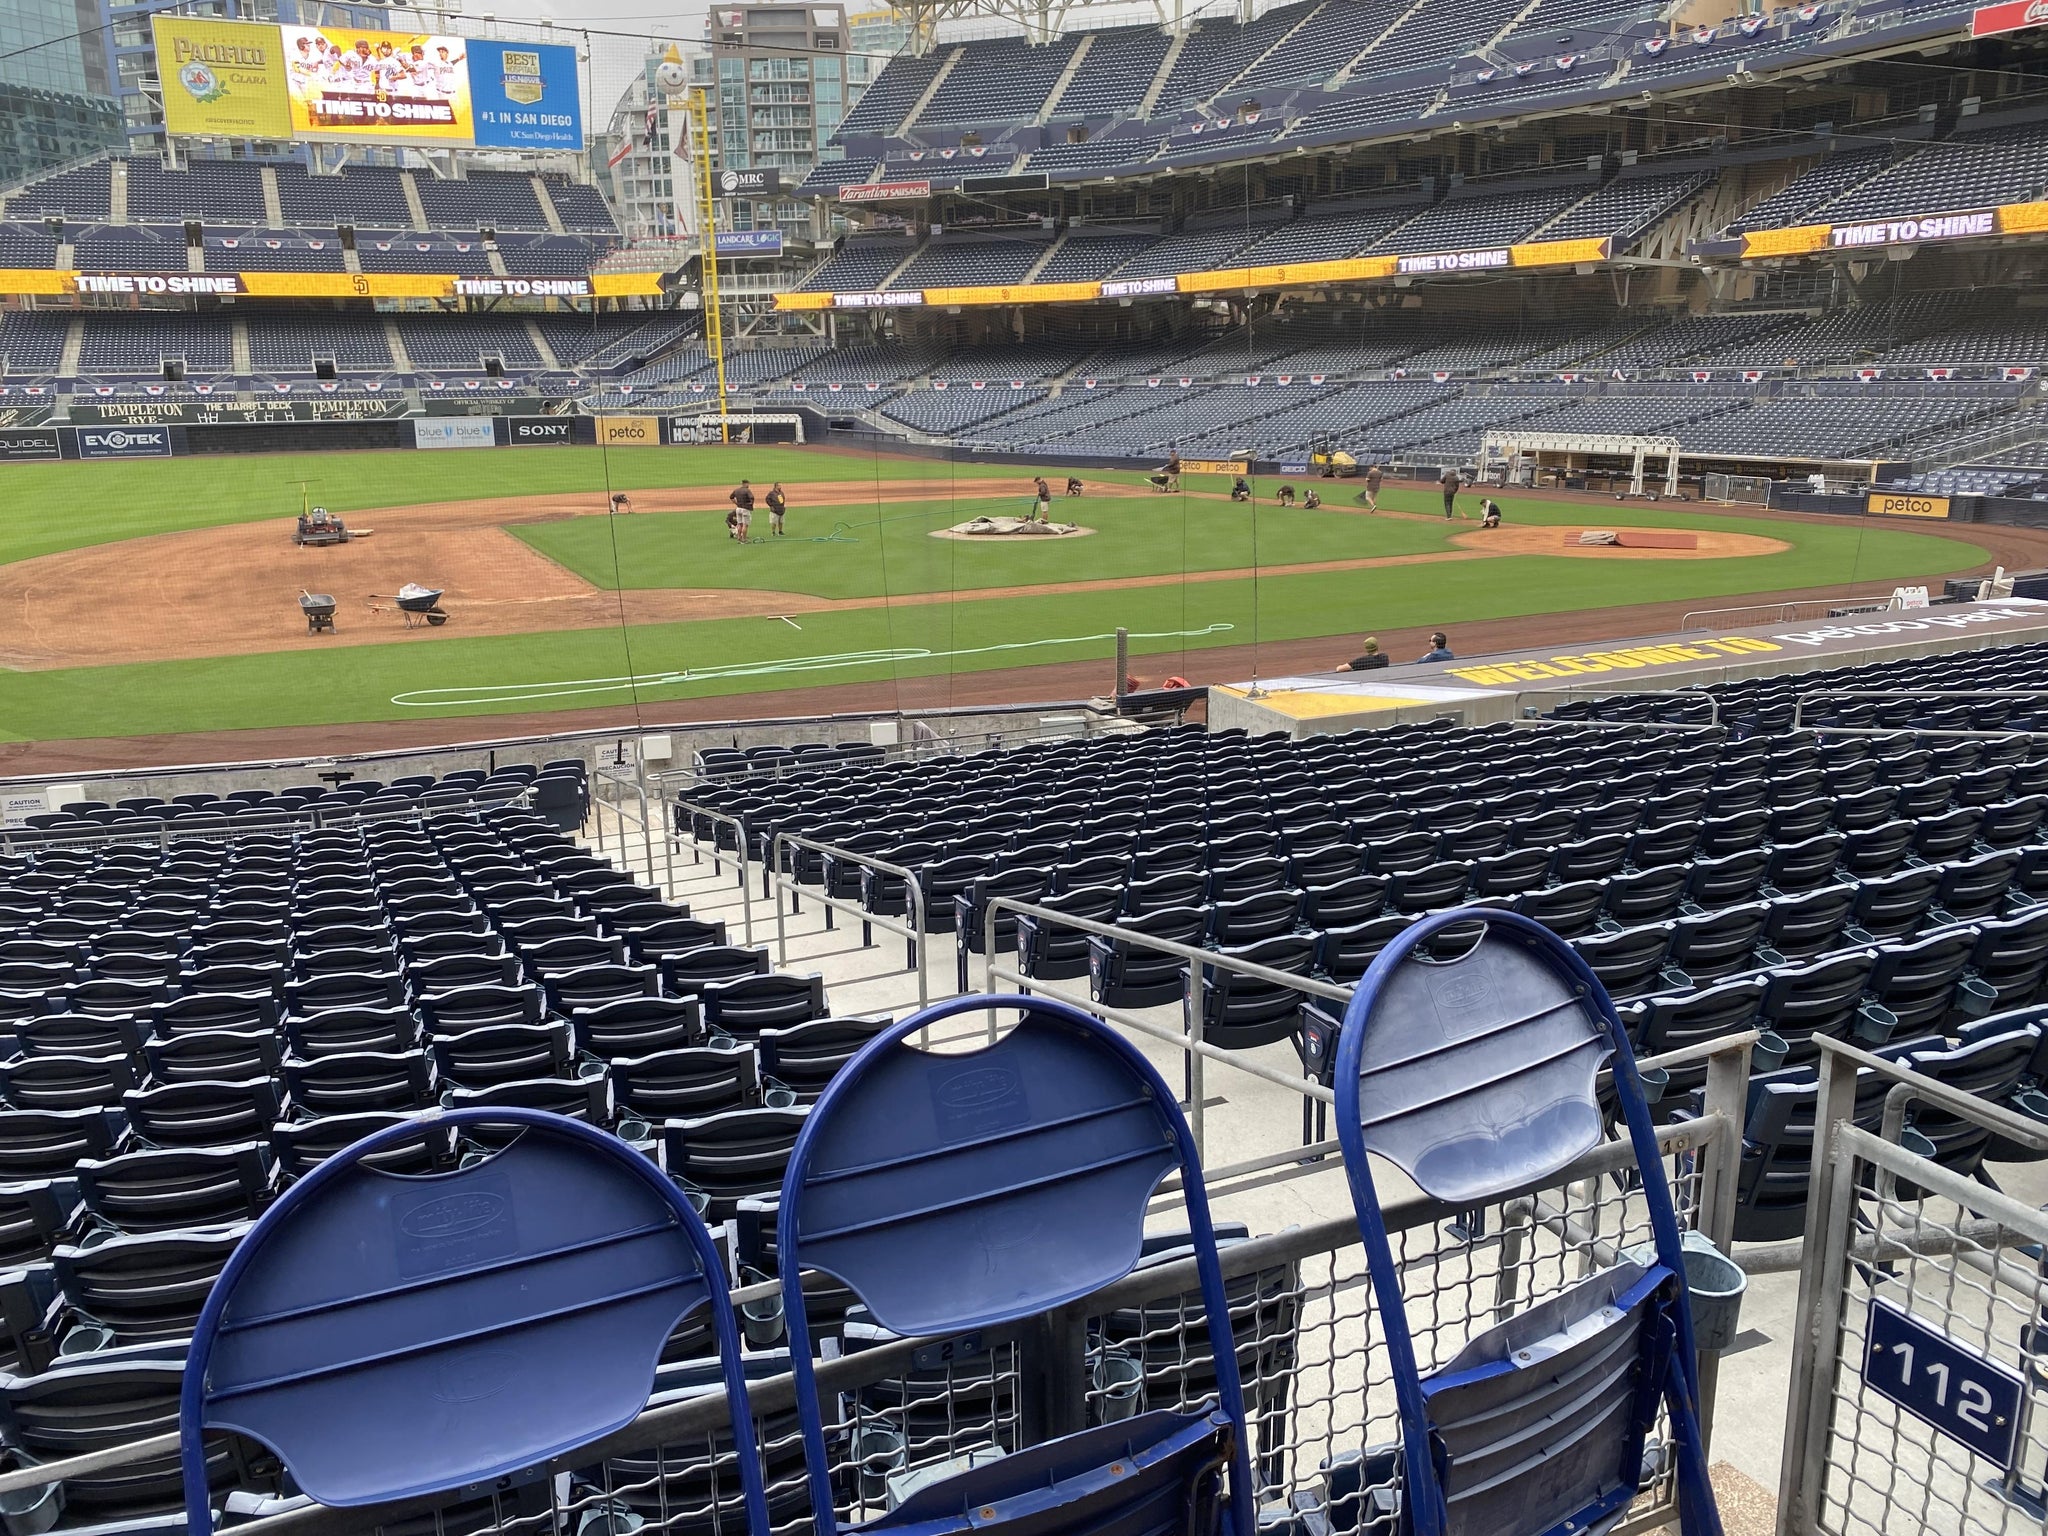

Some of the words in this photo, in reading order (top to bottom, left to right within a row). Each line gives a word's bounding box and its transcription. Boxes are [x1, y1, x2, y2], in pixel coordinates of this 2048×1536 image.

[173, 37, 267, 65] PACIFICO
[505, 53, 537, 66] BEST
[229, 72, 267, 85] CLARA
[311, 99, 363, 116] TIME
[363, 102, 391, 117] TO
[391, 104, 451, 120] SHINE
[482, 111, 496, 123] #1
[500, 112, 511, 124] IN
[515, 113, 537, 125] SAN
[541, 114, 572, 127] DIEGO
[738, 173, 764, 184] MRC
[842, 186, 889, 200] Tarantino
[889, 186, 928, 198] SAUSAGES
[1831, 223, 1887, 246] TIME
[1886, 220, 1919, 241] TO
[1918, 212, 1994, 238] SHINE
[717, 234, 754, 245] LANDCARE
[756, 233, 780, 243] LOGIC
[1398, 256, 1437, 273] TIME
[1436, 254, 1459, 270] TO
[1458, 250, 1508, 268] SHINE
[74, 276, 134, 292] TIME
[133, 276, 164, 292] TO
[168, 277, 237, 292] SHINE
[453, 280, 503, 294] TIME
[503, 280, 527, 295] TO
[531, 280, 588, 295] SHINE
[1101, 282, 1128, 296] TIME
[1127, 281, 1142, 294] TO
[1142, 278, 1176, 293] SHINE
[834, 295, 865, 306] TIME
[865, 294, 883, 305] TO
[883, 292, 922, 304] SHINE
[97, 403, 183, 418] TEMPLETON
[204, 402, 224, 411] THE
[266, 401, 293, 410] DECK
[309, 400, 387, 414] TEMPLETON
[418, 426, 443, 437] blue
[456, 426, 480, 436] blue
[518, 425, 568, 436] SONY
[609, 426, 645, 441] petco
[85, 431, 163, 449] EVOTEK
[1215, 463, 1239, 474] petco
[1883, 497, 1932, 514] petco
[1444, 643, 1722, 686] WELCOME
[1688, 636, 1783, 655] TO
[1770, 619, 1930, 646] petco
[1921, 608, 2046, 628] park
[941, 1341, 954, 1361] 2
[1892, 1342, 1992, 1433] 112
